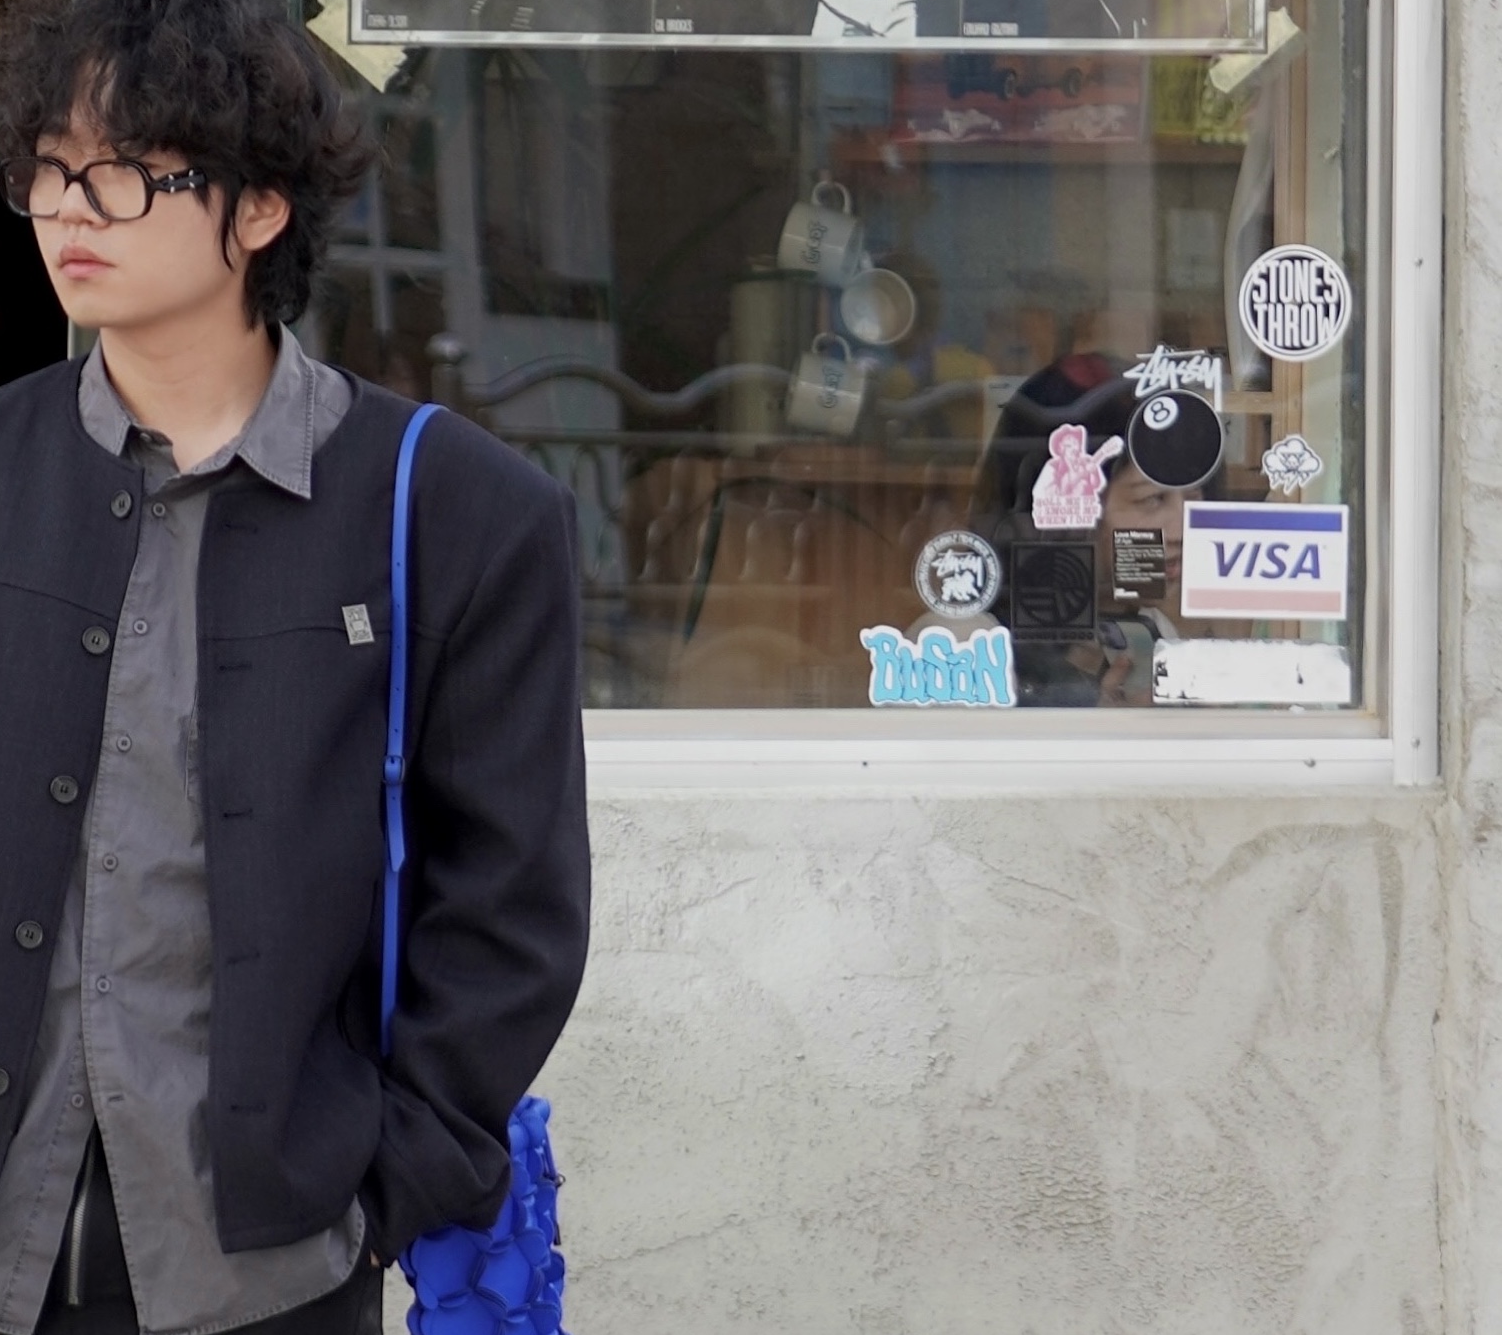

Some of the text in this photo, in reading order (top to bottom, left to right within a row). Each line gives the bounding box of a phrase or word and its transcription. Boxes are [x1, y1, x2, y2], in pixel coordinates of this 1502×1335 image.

[1252, 259, 1338, 304] STONES
[1253, 303, 1336, 348] THROW
[1150, 401, 1171, 423] 8
[1211, 541, 1320, 579] VISA
